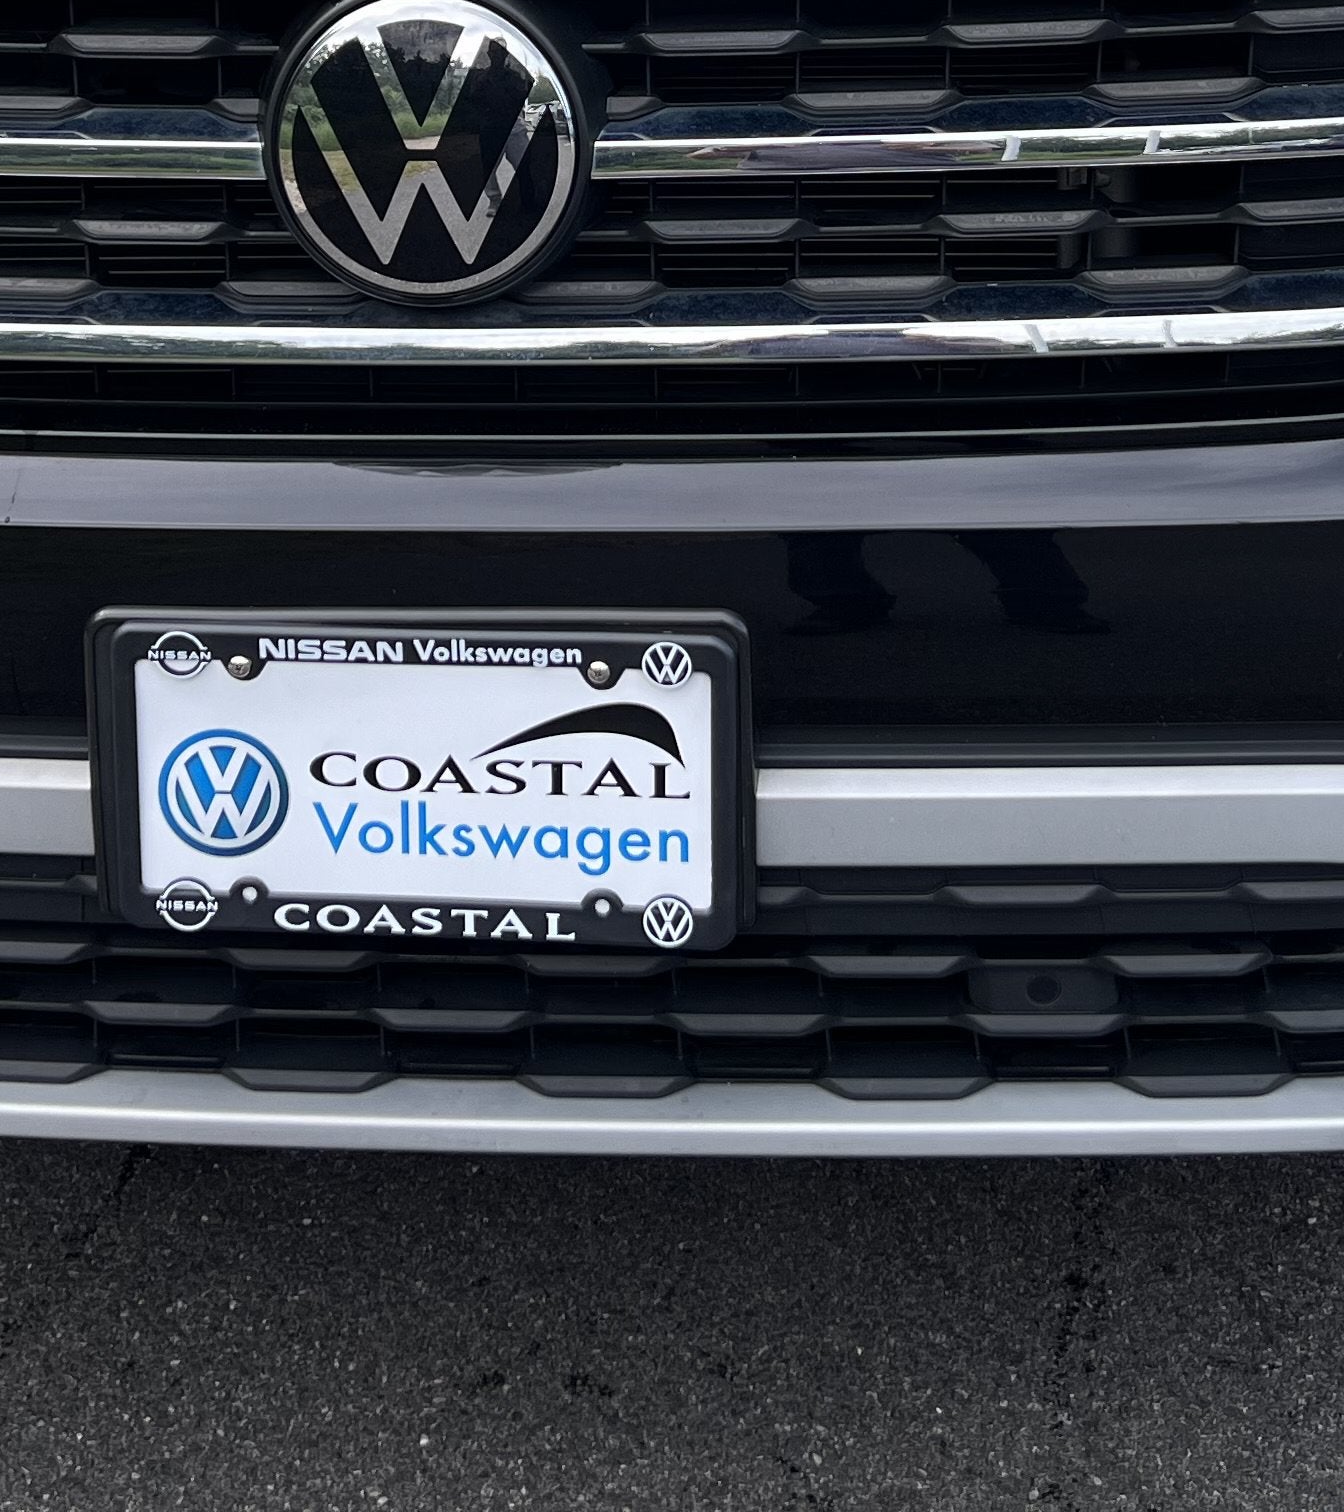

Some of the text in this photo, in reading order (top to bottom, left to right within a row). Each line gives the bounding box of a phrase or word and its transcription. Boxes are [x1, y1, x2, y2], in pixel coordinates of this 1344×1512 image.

[288, 10, 564, 270] VW
[147, 648, 212, 661] NISSAN
[258, 637, 582, 667] NISSAN Volkswagen
[644, 644, 690, 685] VW
[166, 740, 280, 844] VW
[309, 751, 691, 800] COASTAL
[312, 801, 690, 876] Volkswagen
[156, 899, 218, 913] NISSAN
[273, 902, 576, 942] COASTAL
[645, 896, 691, 943] VW
